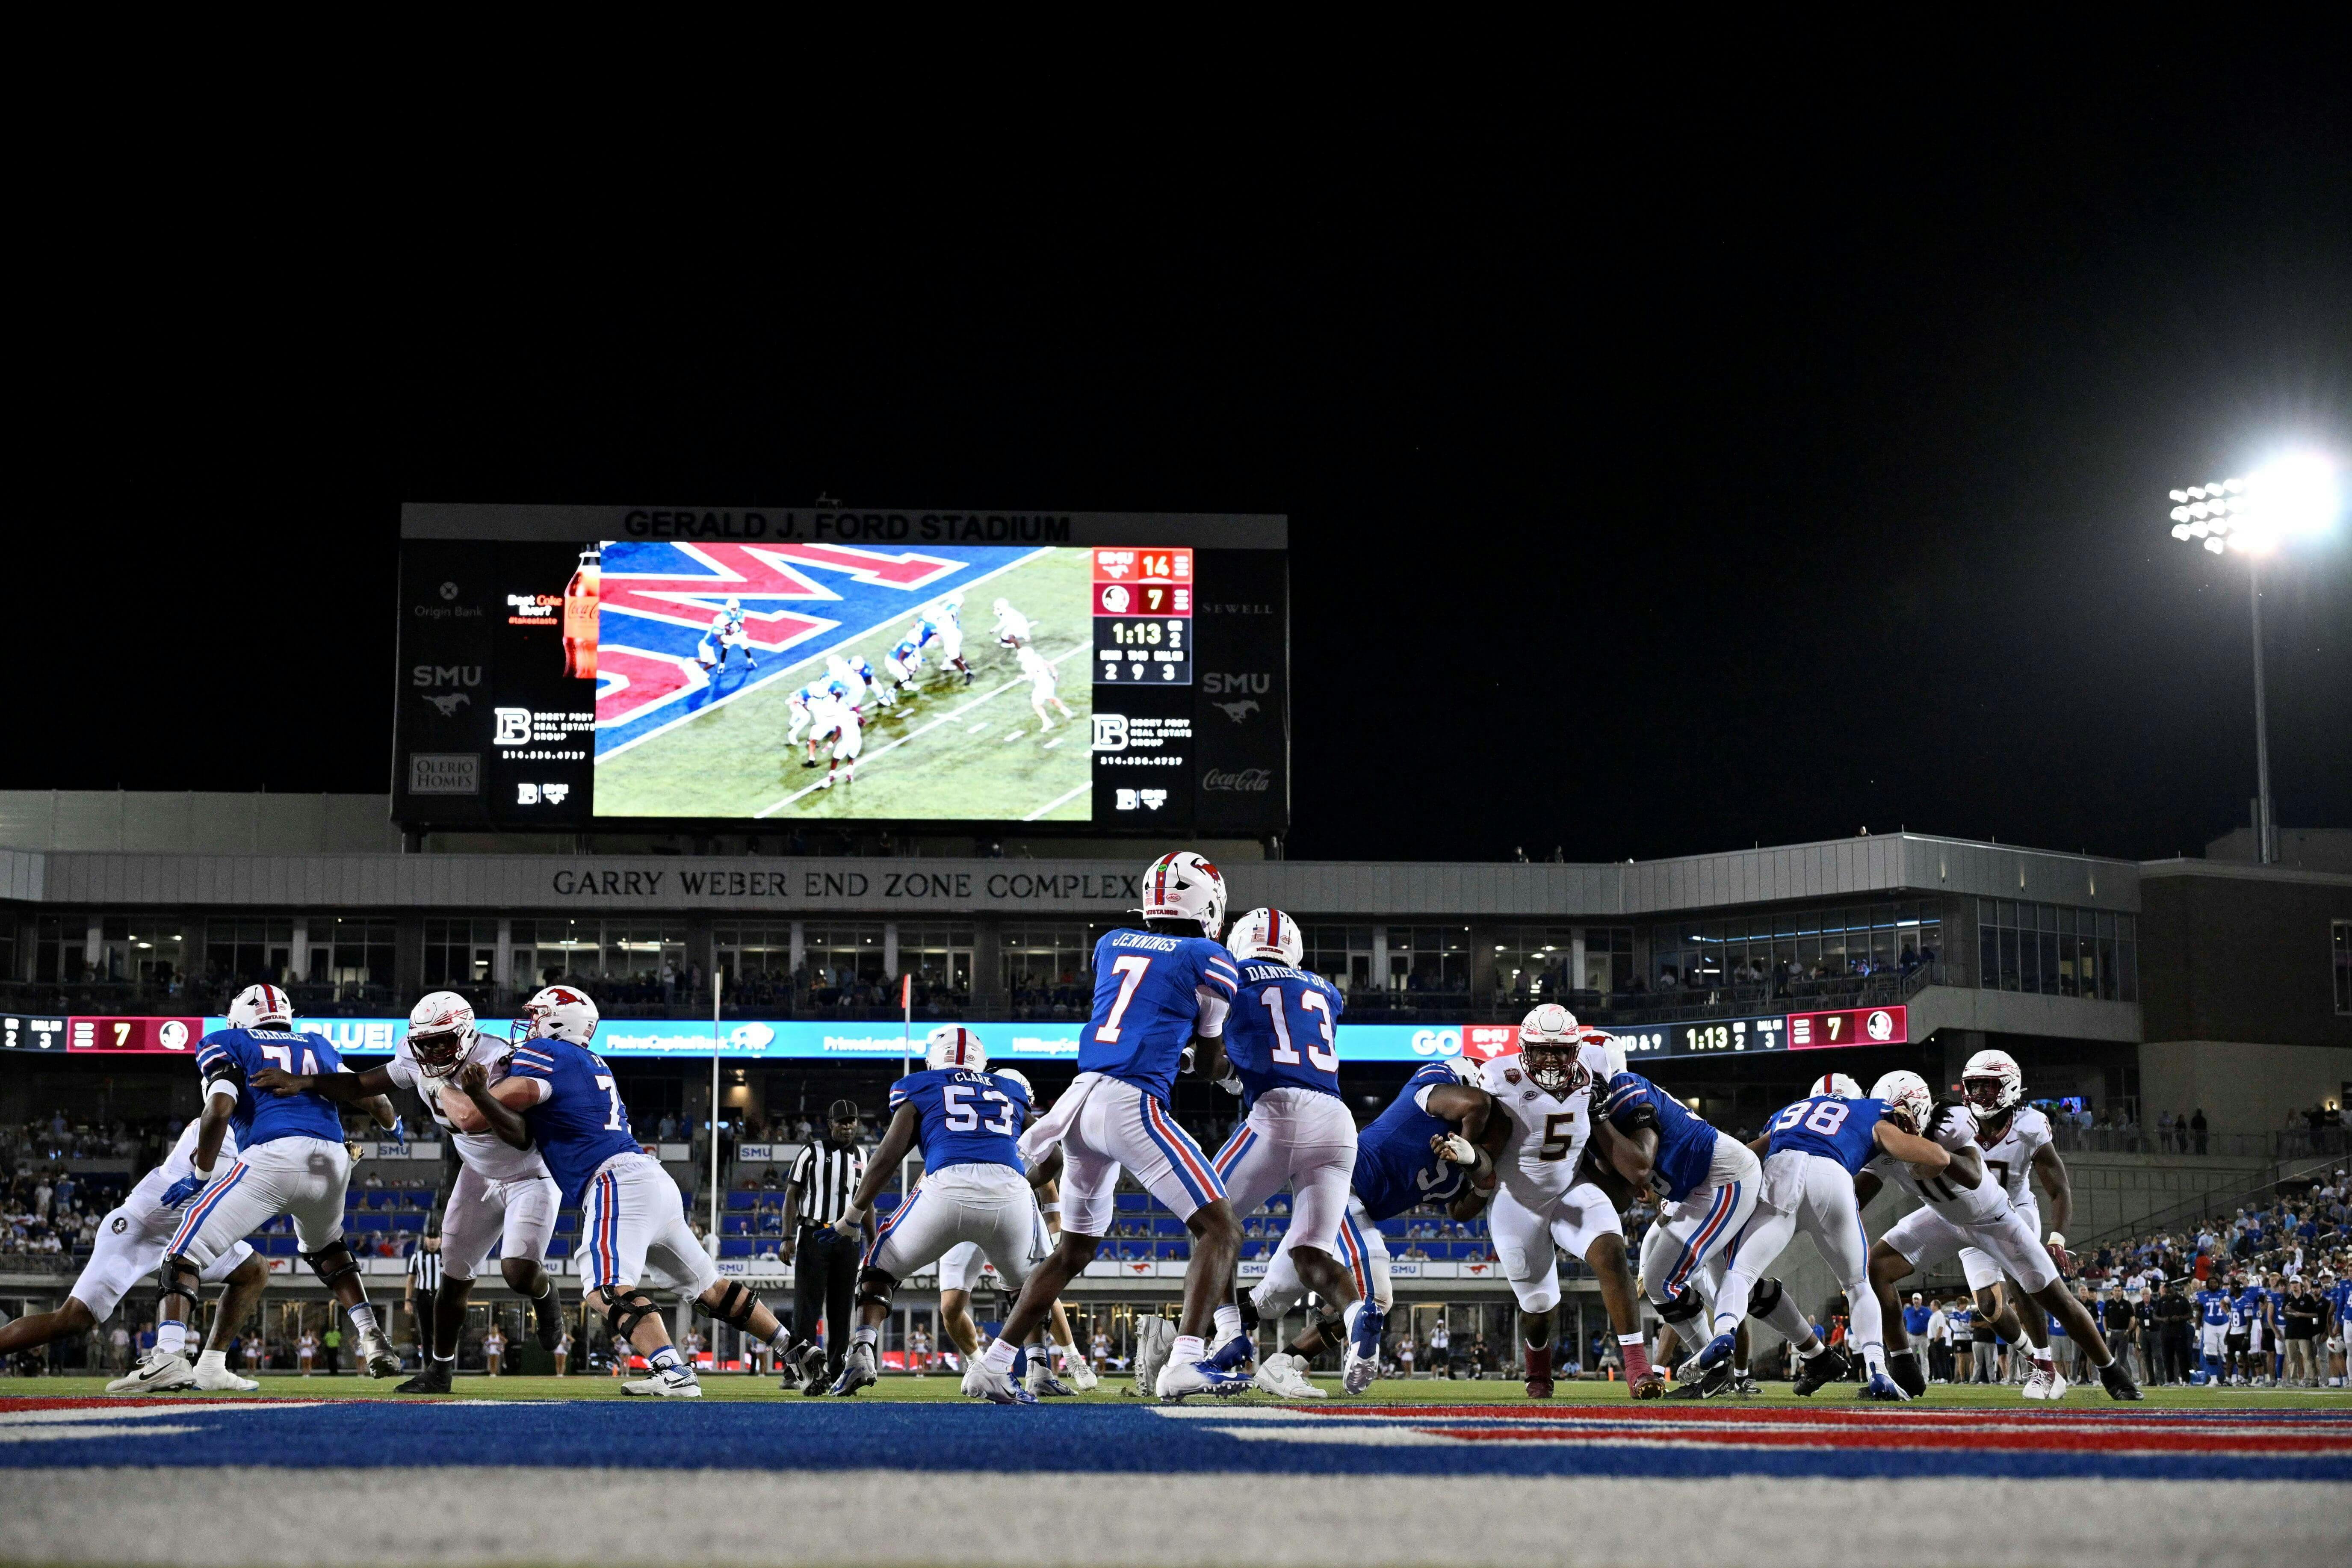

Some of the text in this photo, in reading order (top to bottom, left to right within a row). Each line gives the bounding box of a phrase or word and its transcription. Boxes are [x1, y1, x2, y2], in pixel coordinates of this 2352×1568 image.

[625, 511, 1070, 542] GERALD J. FORD STADIUM
[1143, 555, 1170, 576] 14
[537, 594, 562, 606] Coke
[1147, 589, 1163, 610] 7
[414, 605, 482, 619] Origin Bank
[1202, 602, 1273, 614] SEWELL
[508, 617, 558, 625] #takeataste
[1113, 623, 1161, 644] 1:13
[1169, 632, 1181, 648] 2
[413, 665, 482, 686] SMU
[1105, 663, 1117, 680] 2
[1132, 664, 1144, 680] 9
[1163, 664, 1175, 680] 3
[1203, 673, 1271, 694] SMU
[418, 774, 472, 787] HOMES
[553, 870, 1139, 899] GARRY WEBER END ZONE COMPLEX
[1112, 932, 1182, 952] JENNINGS
[1256, 947, 1284, 955] MUSTANGS
[1245, 965, 1330, 993] DANIELS JR.
[1094, 954, 1153, 1044] 7
[259, 1014, 287, 1022] MUSTANGS
[113, 1022, 131, 1047] 7
[247, 1028, 309, 1043] CHAMBLEE
[1260, 985, 1339, 1073] 13
[1827, 1017, 1841, 1041] 7
[6, 1030, 17, 1047] 2
[40, 1033, 52, 1048] 3
[1411, 1029, 1462, 1056] GO
[1652, 1034, 1662, 1050] 9
[1686, 1026, 1729, 1051] 1:13
[1734, 1034, 1744, 1050] 2
[1765, 1032, 1775, 1048] 3
[954, 1072, 994, 1087] CLARK
[943, 1085, 1015, 1137] 53
[1539, 1111, 1575, 1163] 5
[379, 1146, 409, 1155] SMU
[741, 1148, 770, 1157] SMU
[1242, 1265, 1267, 1274] SMU
[1391, 1265, 1416, 1274] SMU
